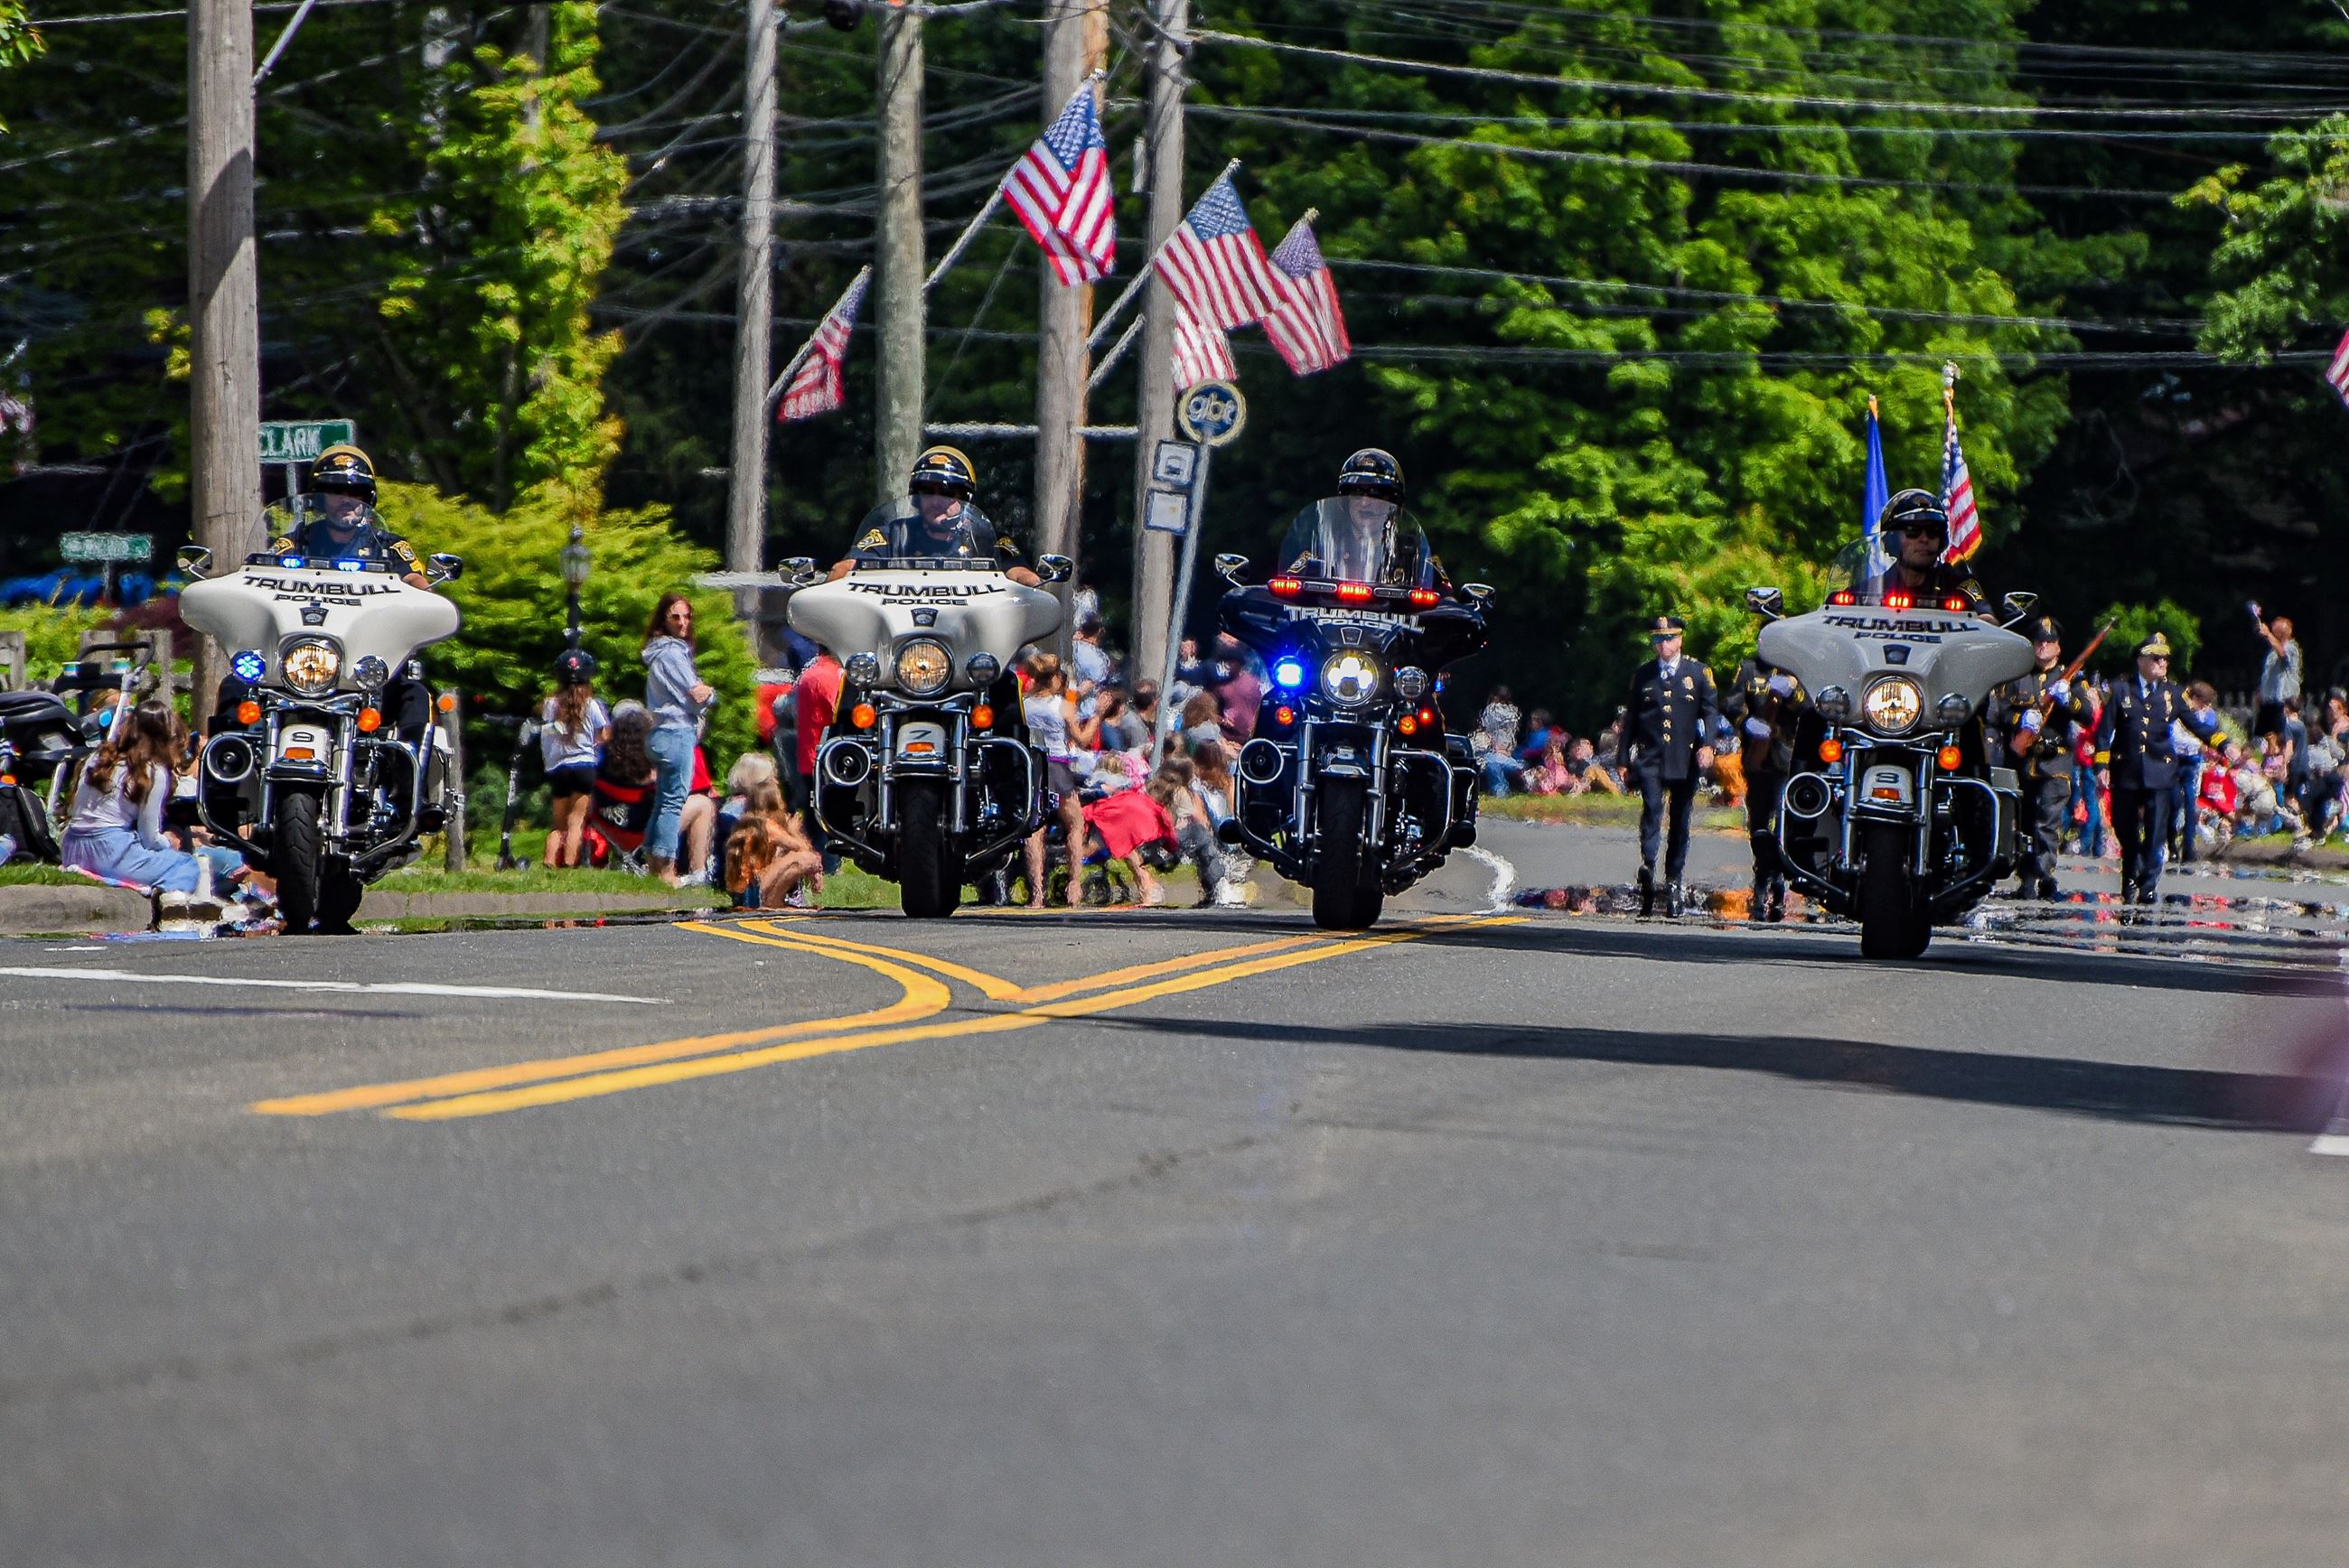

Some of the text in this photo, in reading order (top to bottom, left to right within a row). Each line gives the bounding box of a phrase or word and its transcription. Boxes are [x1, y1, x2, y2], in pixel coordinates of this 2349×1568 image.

[243, 575, 402, 596] TRUMBULL
[847, 582, 1006, 597] TRUMBULL
[273, 593, 362, 607] POLICE
[881, 598, 969, 606] POLICE
[1283, 603, 1426, 634] TRUMBULL
[1317, 618, 1394, 631] POLICE
[1822, 614, 1980, 633] TRUMBULL
[1854, 631, 1943, 644] POLICE
[910, 730, 931, 739] 7
